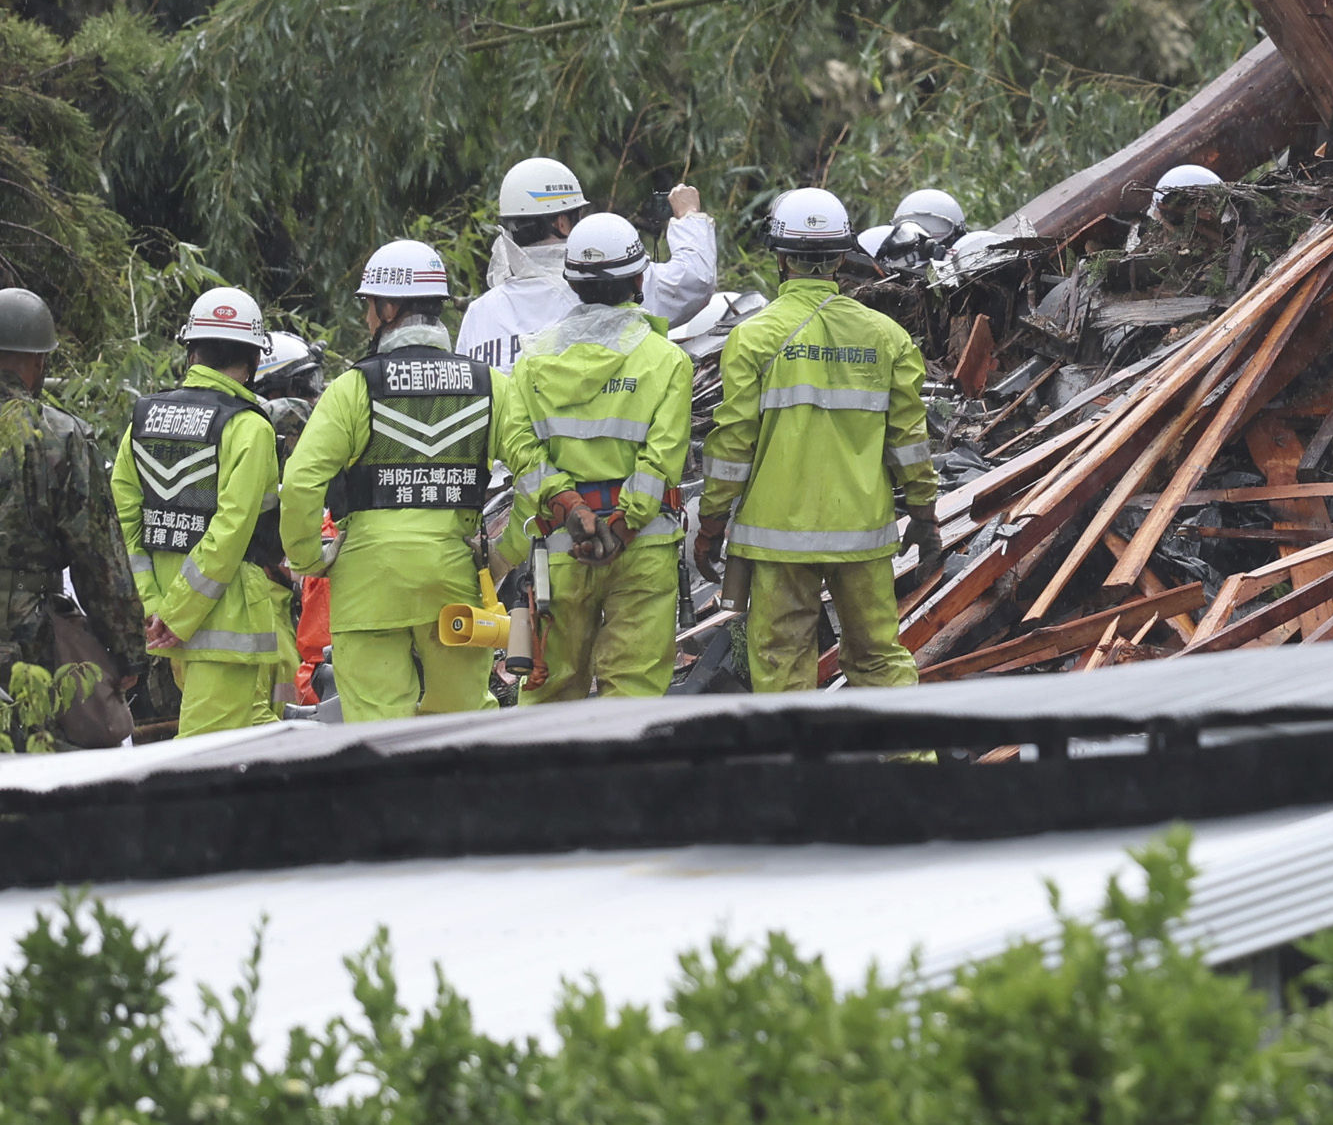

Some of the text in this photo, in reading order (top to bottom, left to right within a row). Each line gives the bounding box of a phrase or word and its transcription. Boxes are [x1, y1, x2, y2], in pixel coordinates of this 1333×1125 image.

[783, 343, 877, 364] 名古屋市消防局
[386, 360, 473, 390] 名古屋市消防局
[144, 403, 214, 437] 名古屋市消防局
[378, 468, 477, 486] 消防広域応援
[396, 486, 462, 504] 指揮隊
